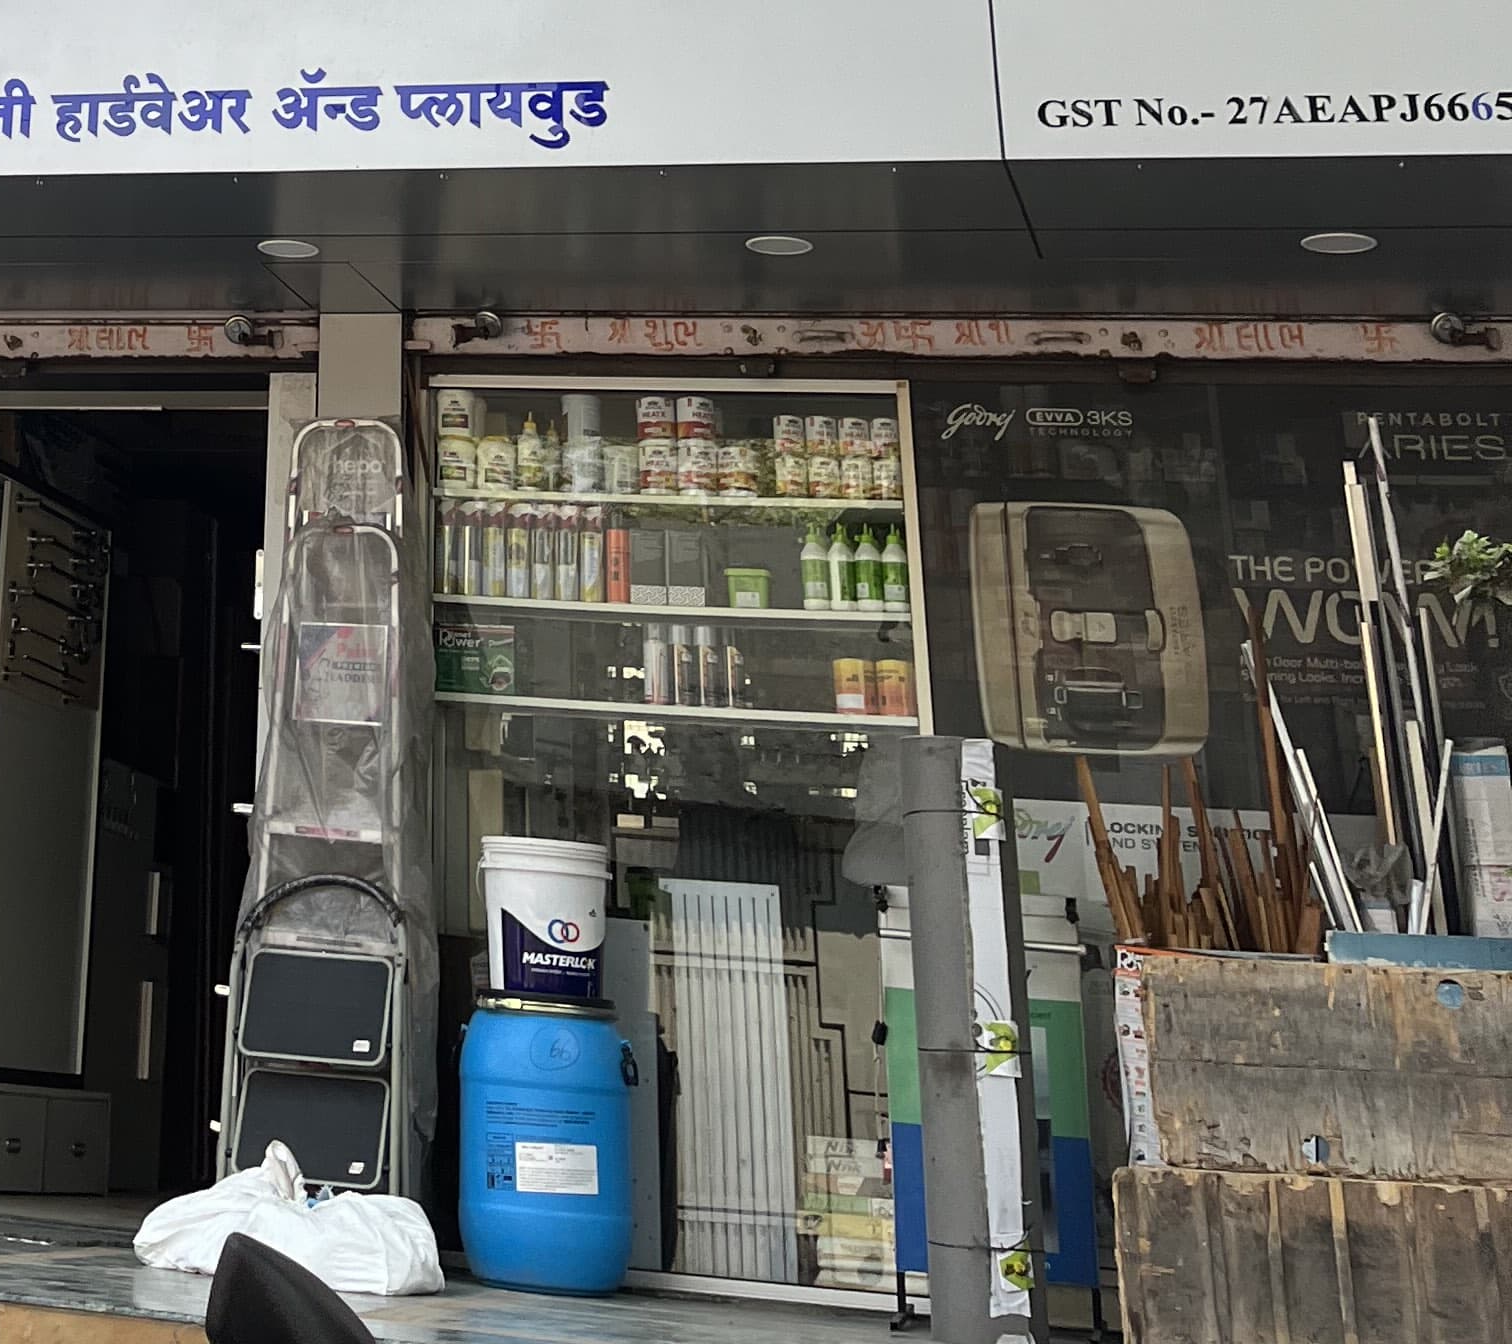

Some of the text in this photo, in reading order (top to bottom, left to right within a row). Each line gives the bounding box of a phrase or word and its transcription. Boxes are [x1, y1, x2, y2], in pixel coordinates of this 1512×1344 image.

[50, 71, 252, 143] हार्डवेअर
[394, 75, 610, 150] प्लायवुड
[1037, 97, 1123, 130] GST
[1227, 88, 1512, 126] 27AEAPJ6665
[941, 404, 1134, 441] Godrej EVVA 3KS
[1029, 427, 1134, 439] TECHNOLOGY
[1228, 555, 1296, 583] THE
